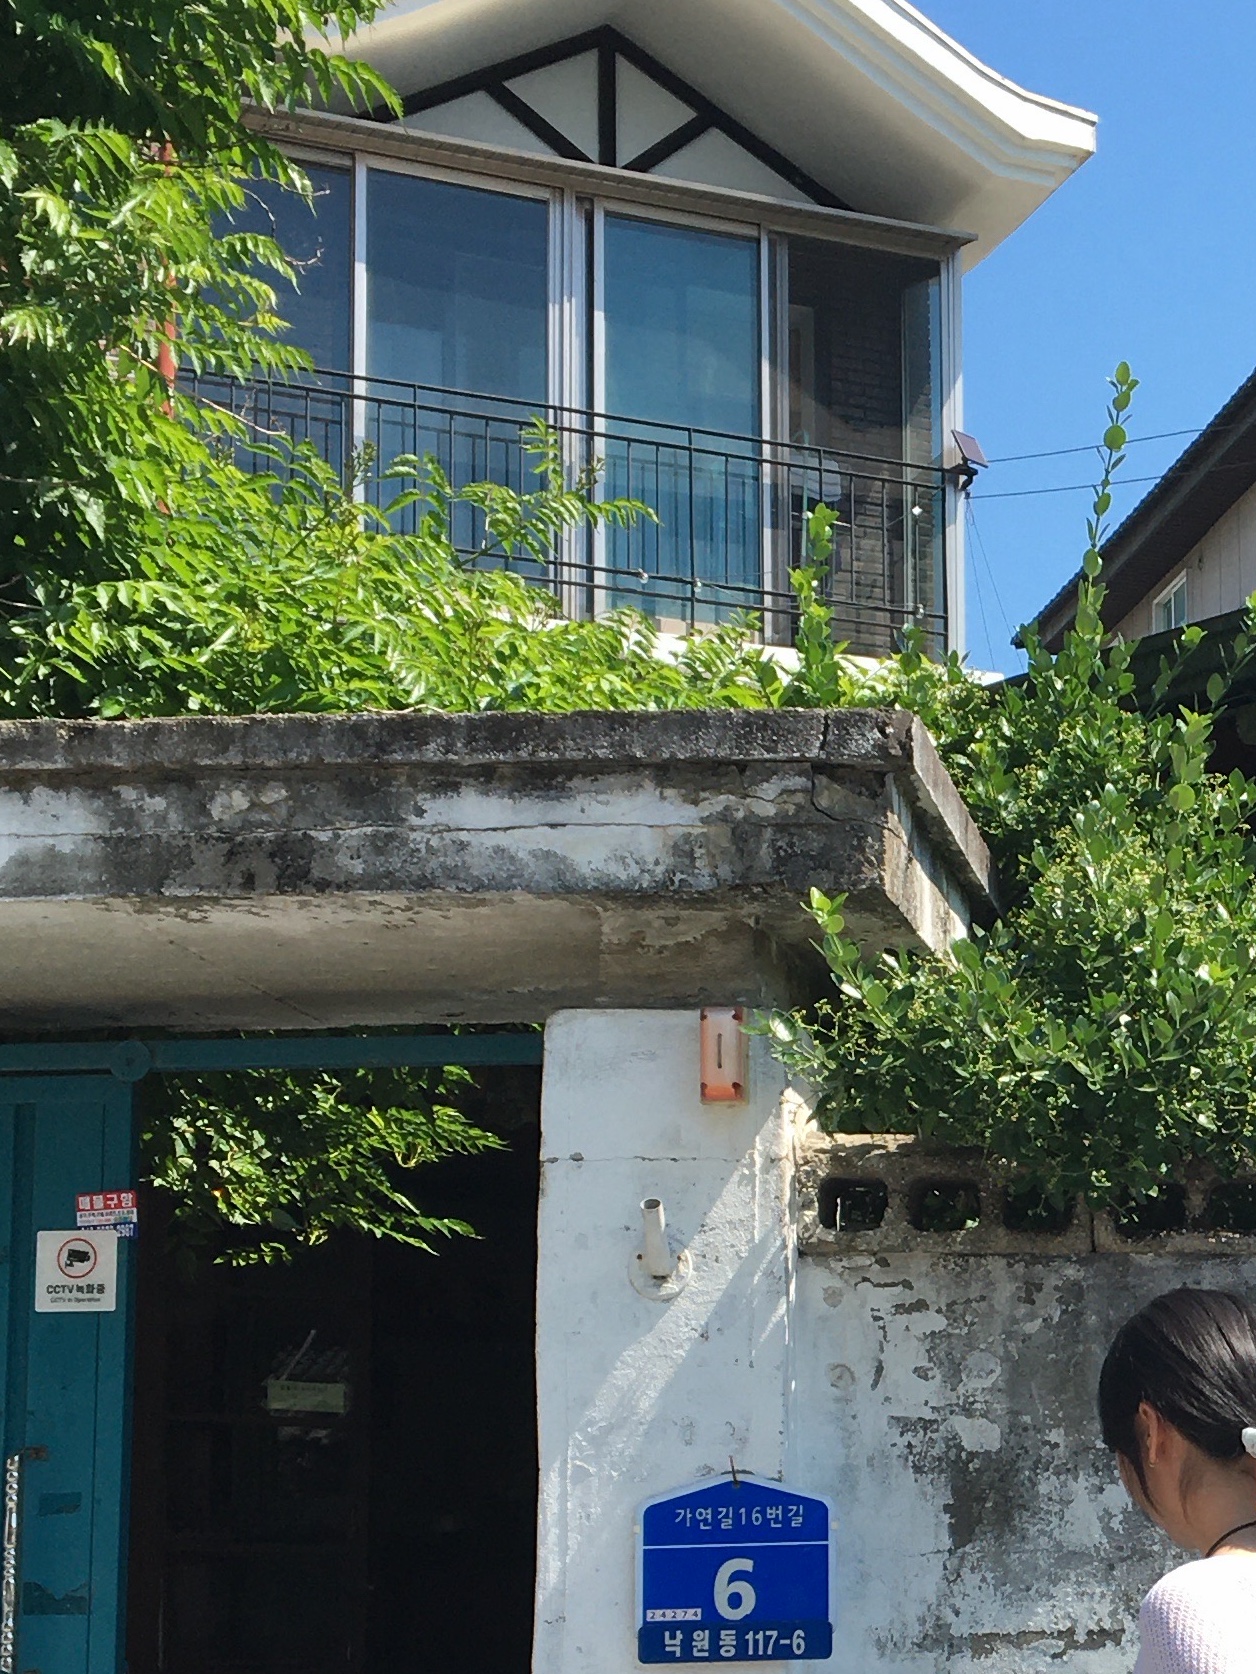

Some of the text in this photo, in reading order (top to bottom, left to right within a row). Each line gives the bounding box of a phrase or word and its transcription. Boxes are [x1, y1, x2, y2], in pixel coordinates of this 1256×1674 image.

[675, 1505, 804, 1530] 가연길16번길
[713, 1557, 757, 1621] 6
[650, 1610, 699, 1620] 24274
[664, 1629, 806, 1658] 낙원동 117-6
